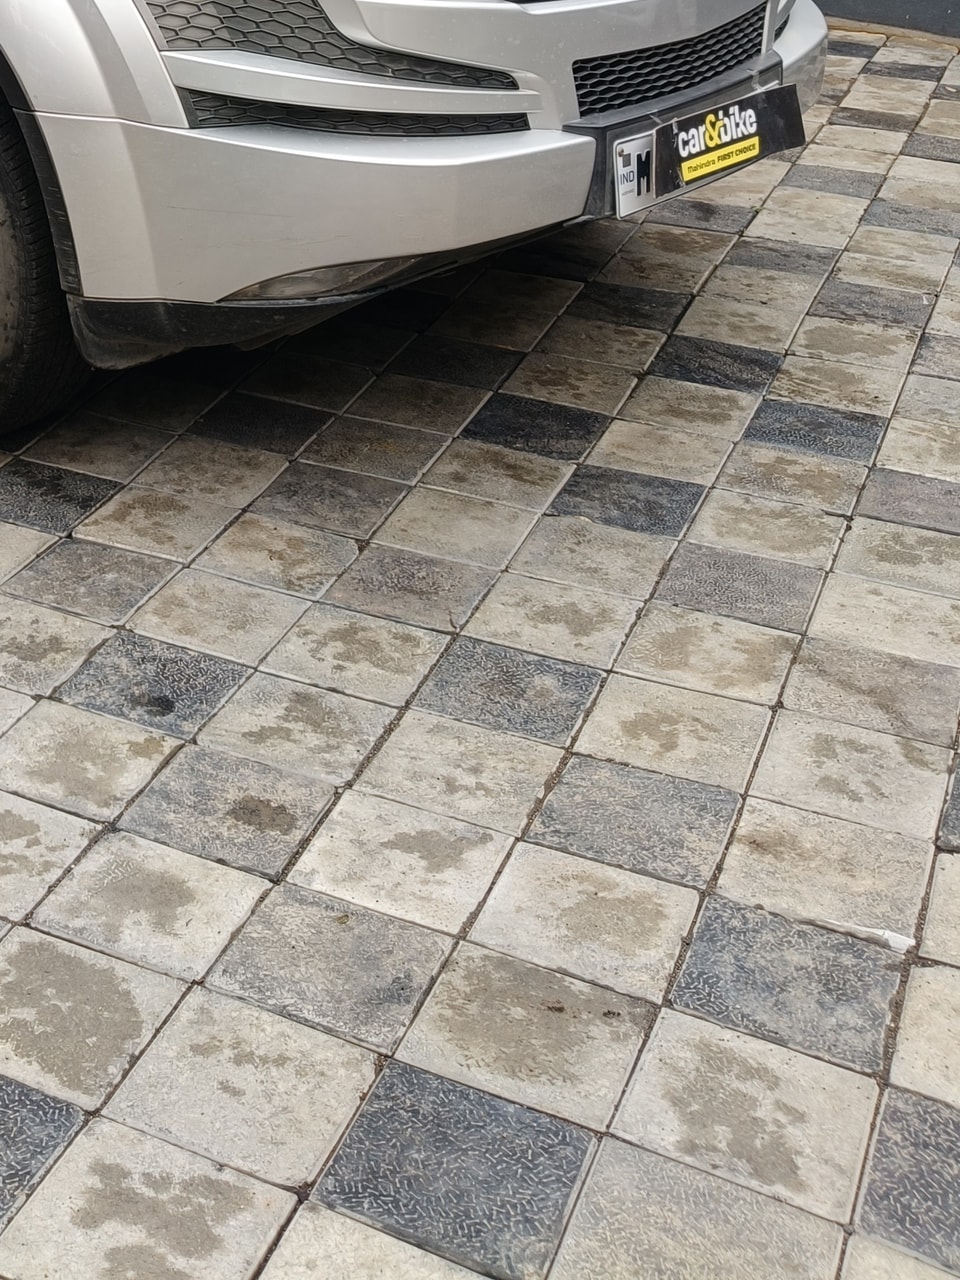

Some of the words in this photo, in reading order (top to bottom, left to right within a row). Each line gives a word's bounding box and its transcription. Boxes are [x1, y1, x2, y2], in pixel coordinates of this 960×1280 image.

[678, 105, 757, 157] car&bike
[687, 158, 716, 173] Mahindra
[717, 151, 734, 164] FIRST
[735, 143, 756, 157] CHOICE
[620, 170, 635, 185] IND
